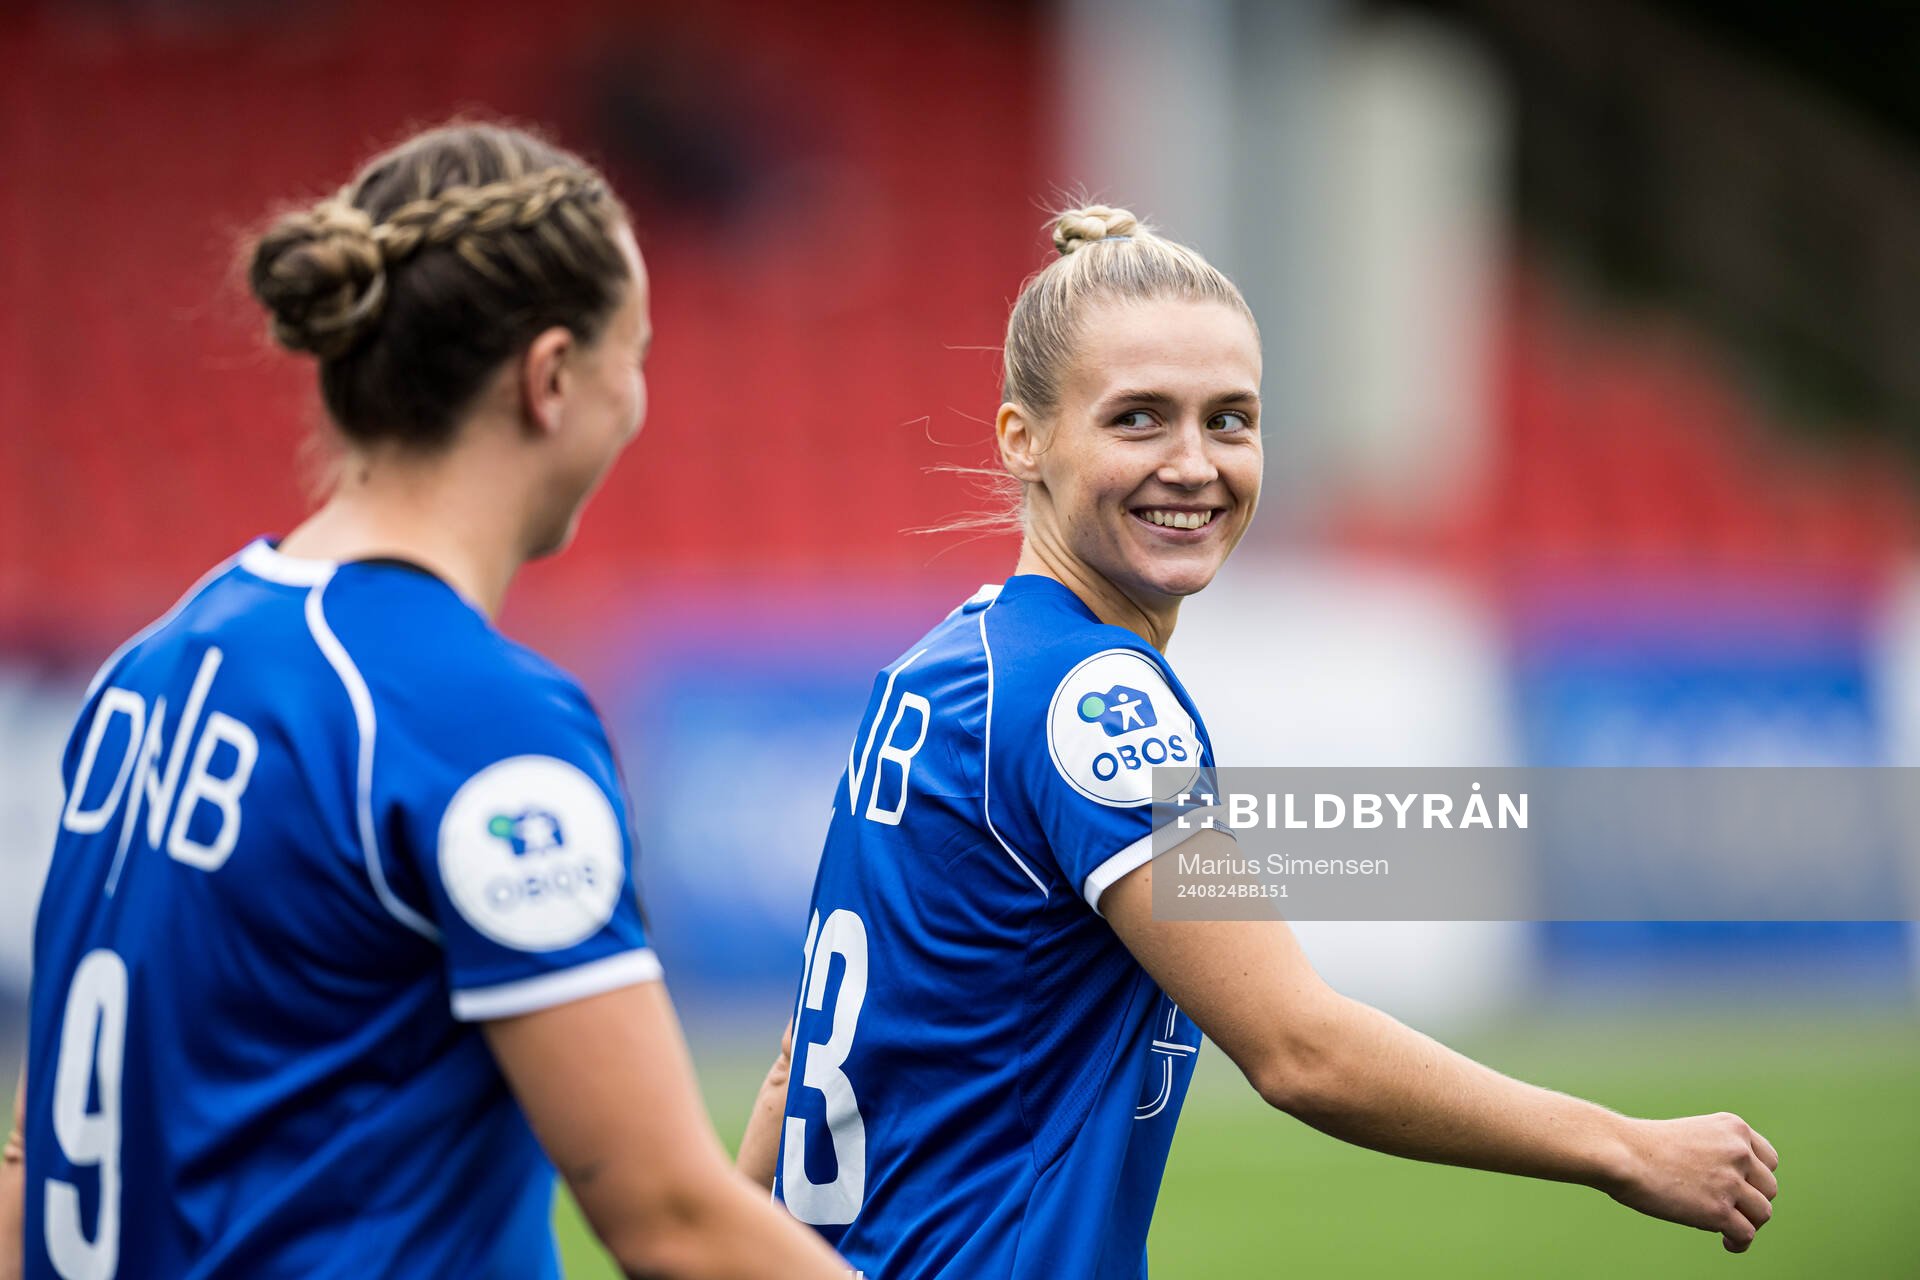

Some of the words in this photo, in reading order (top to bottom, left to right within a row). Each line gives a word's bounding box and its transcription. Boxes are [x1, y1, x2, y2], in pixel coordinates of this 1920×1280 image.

[62, 646, 259, 899] DNB
[1092, 734, 1188, 782] OBOS
[43, 947, 130, 1280] 9
[774, 907, 869, 1226] 3
